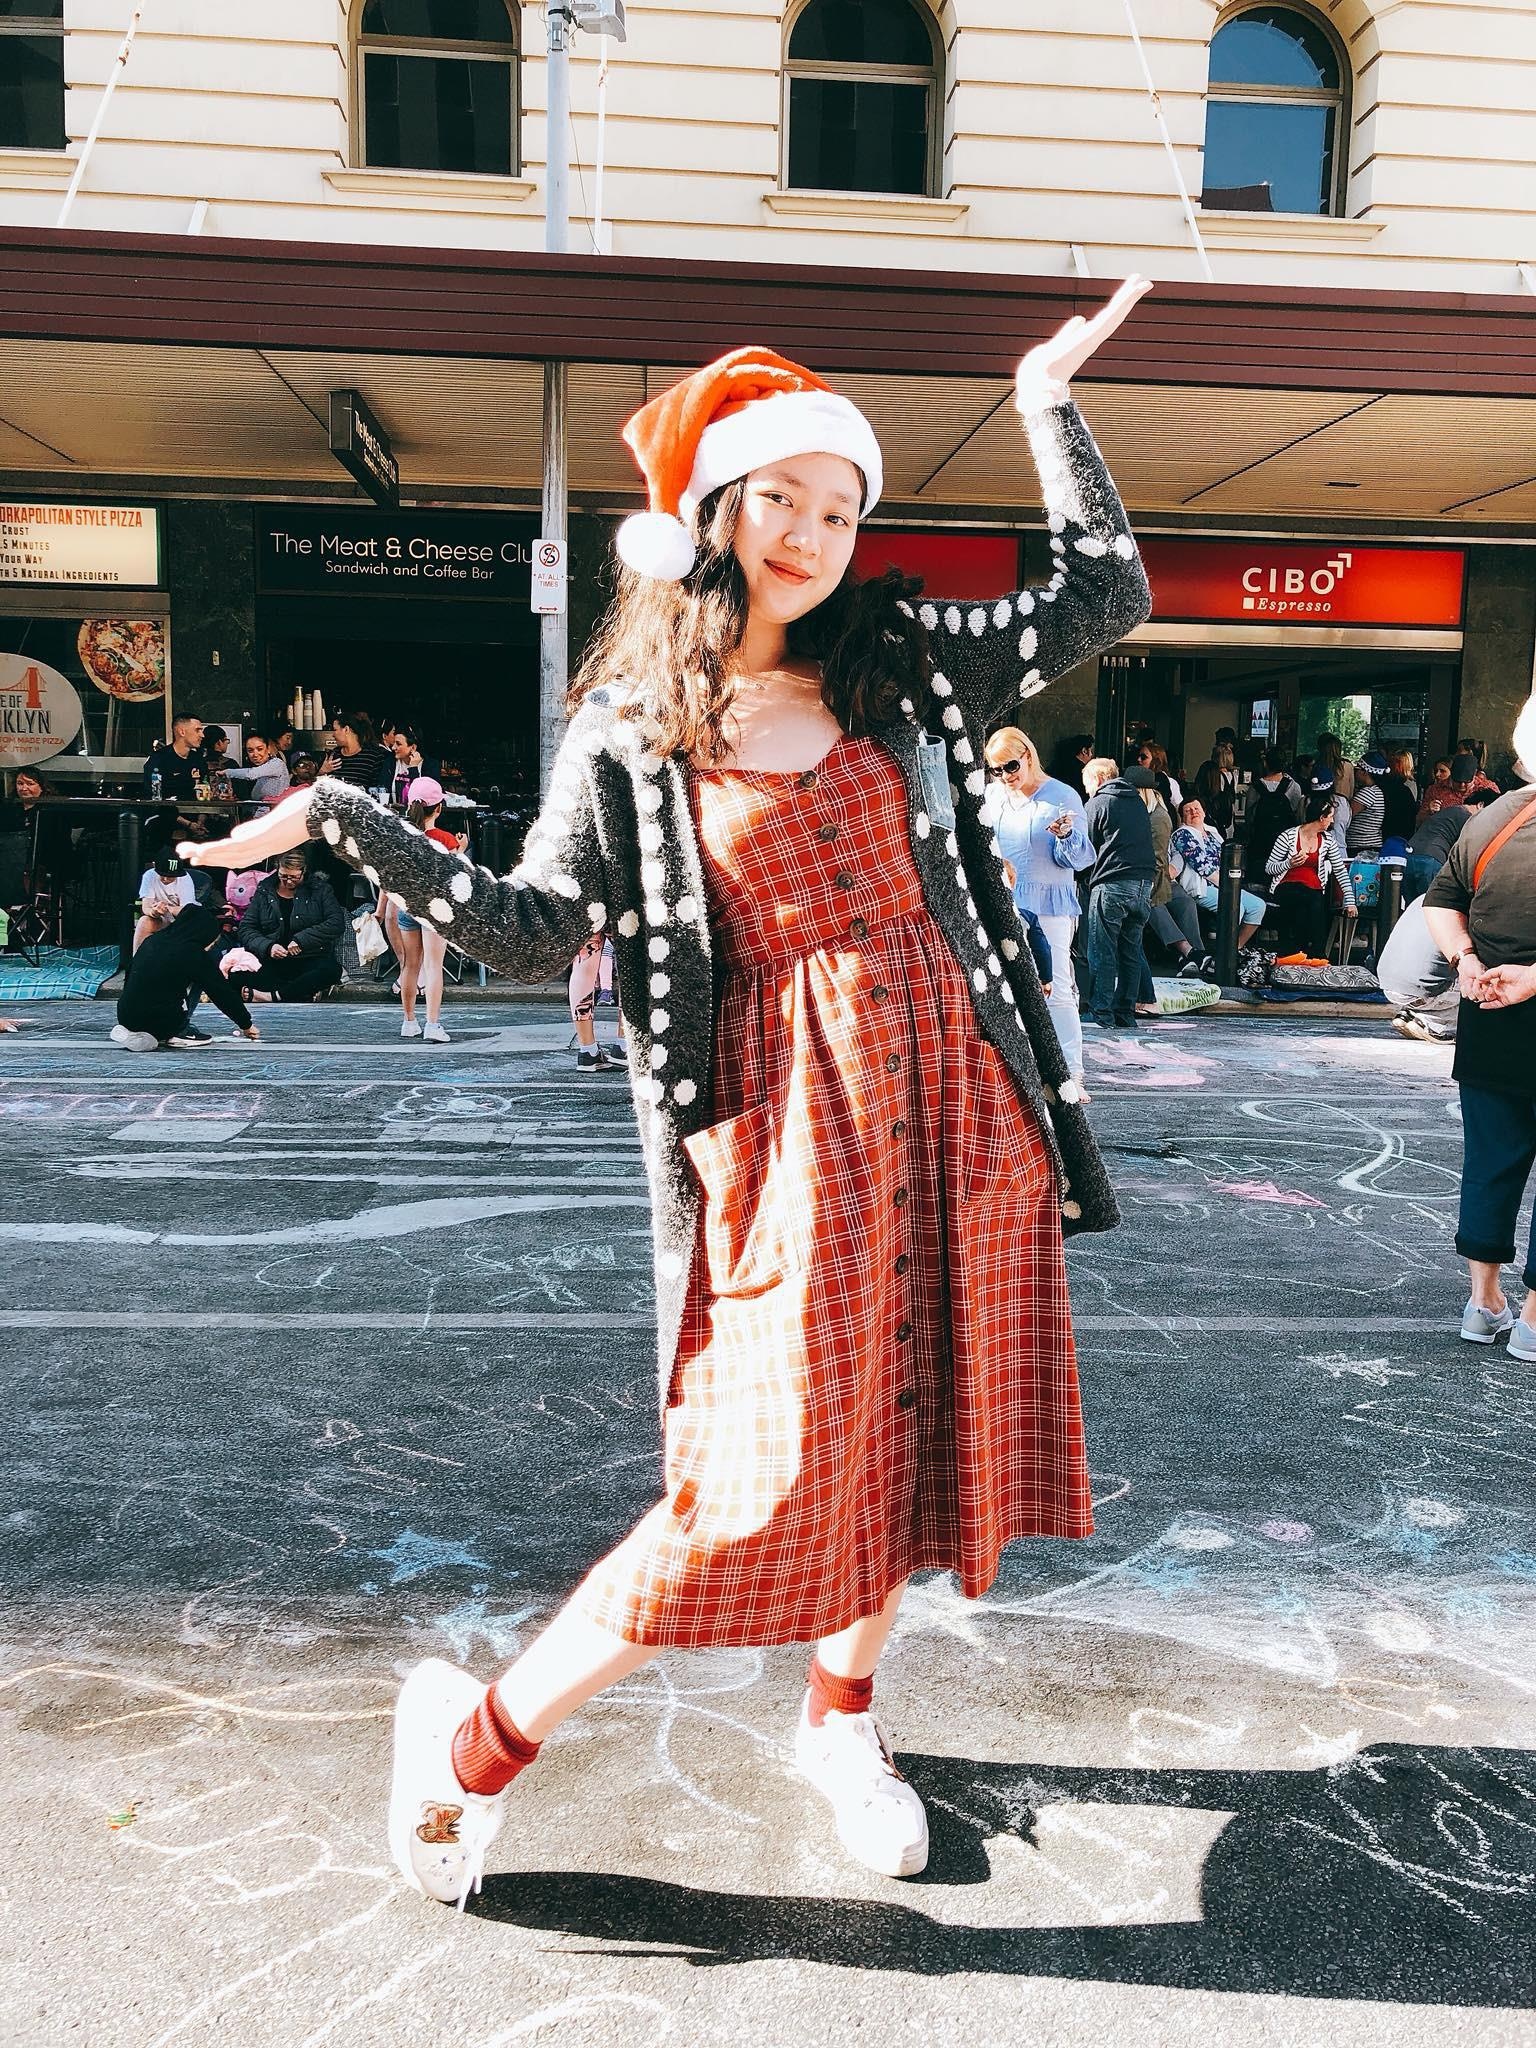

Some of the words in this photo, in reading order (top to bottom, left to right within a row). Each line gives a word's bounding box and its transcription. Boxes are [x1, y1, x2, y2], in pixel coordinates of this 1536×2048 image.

[75, 509, 107, 526] STYLE
[110, 510, 143, 528] PIZZA
[269, 532, 313, 554] The
[320, 534, 378, 557] Meat
[385, 537, 402, 558] &
[408, 538, 493, 562] Cheese
[500, 542, 533, 564] Clu
[325, 560, 389, 575] Sandwich
[393, 564, 418, 576] and
[423, 564, 467, 578] Coffee
[472, 566, 494, 579] Bar
[547, 573, 560, 581] ALL
[1242, 567, 1335, 595] CIBO
[1256, 597, 1331, 614] Espresso
[9, 694, 22, 708] OF
[0, 709, 51, 734] KLYN
[43, 737, 66, 745] PIZZA
